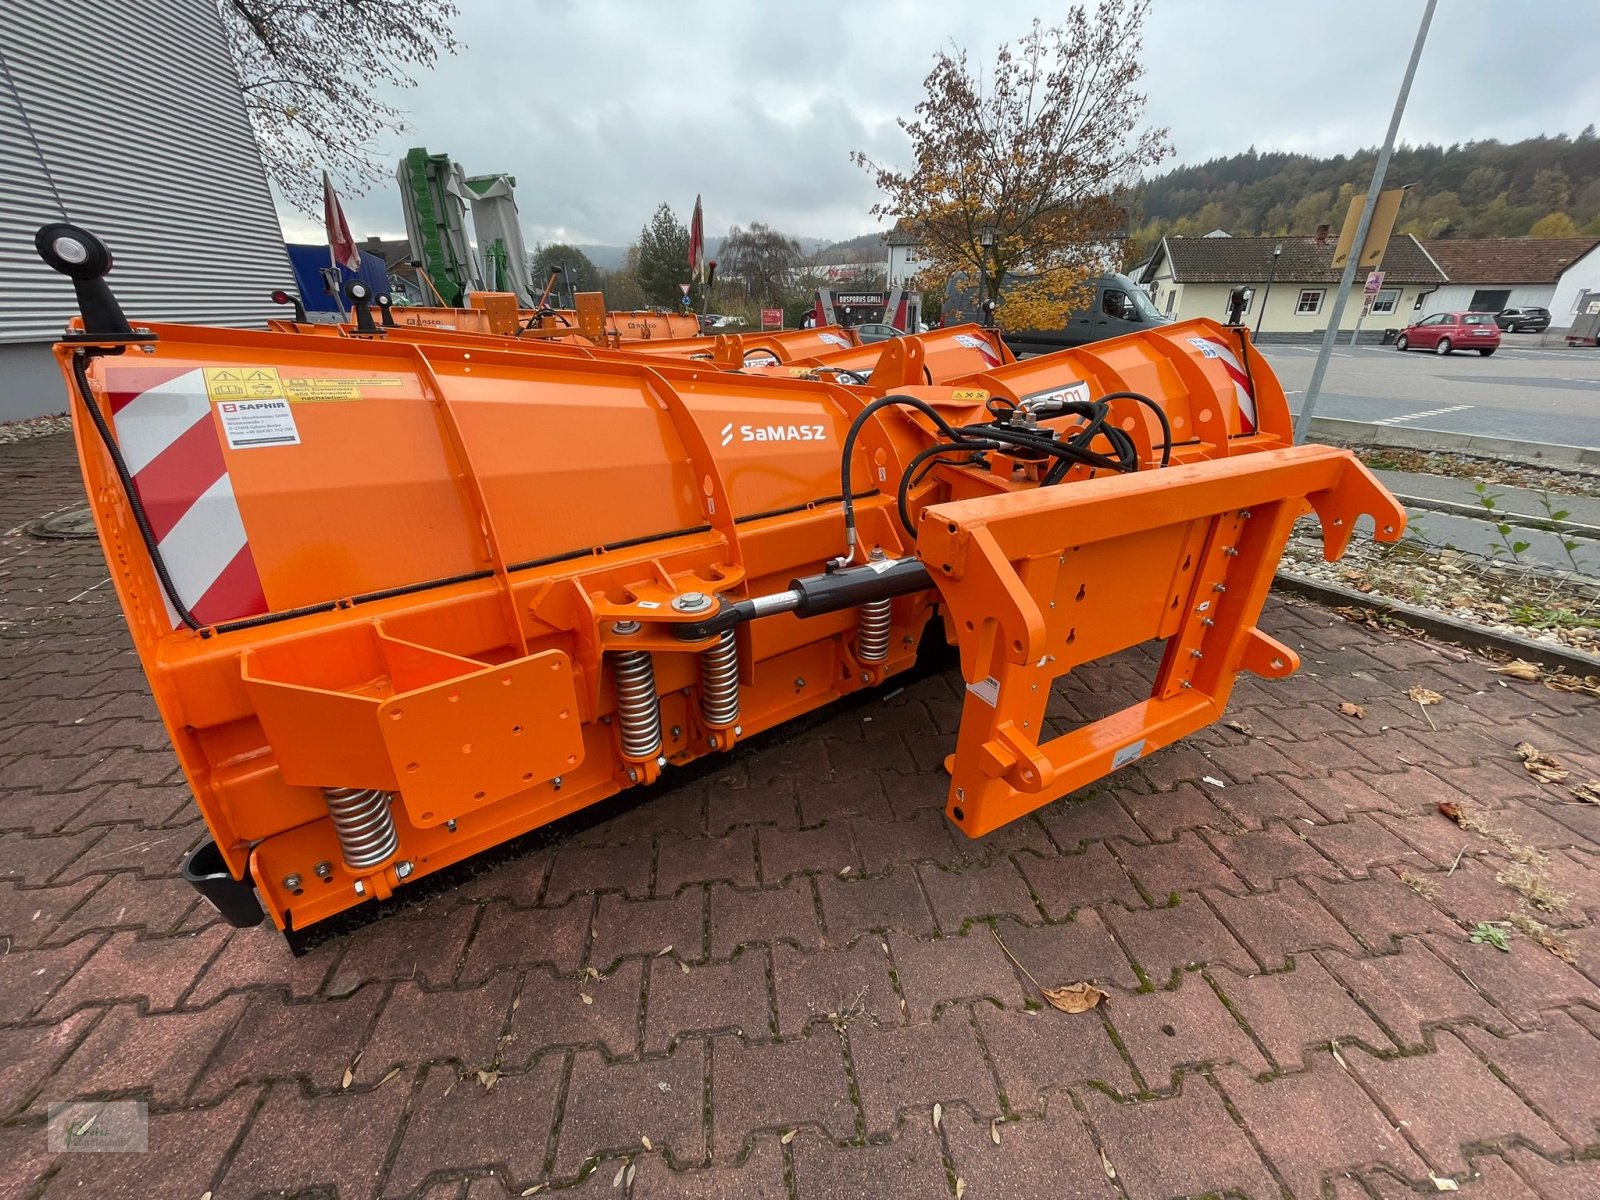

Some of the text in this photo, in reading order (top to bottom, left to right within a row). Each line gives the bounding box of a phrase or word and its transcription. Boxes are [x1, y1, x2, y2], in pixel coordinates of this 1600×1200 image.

[839, 295, 881, 303] BOSPORUS GRILL
[239, 402, 285, 411] SAPHIR
[740, 425, 827, 442] SaMASZ
